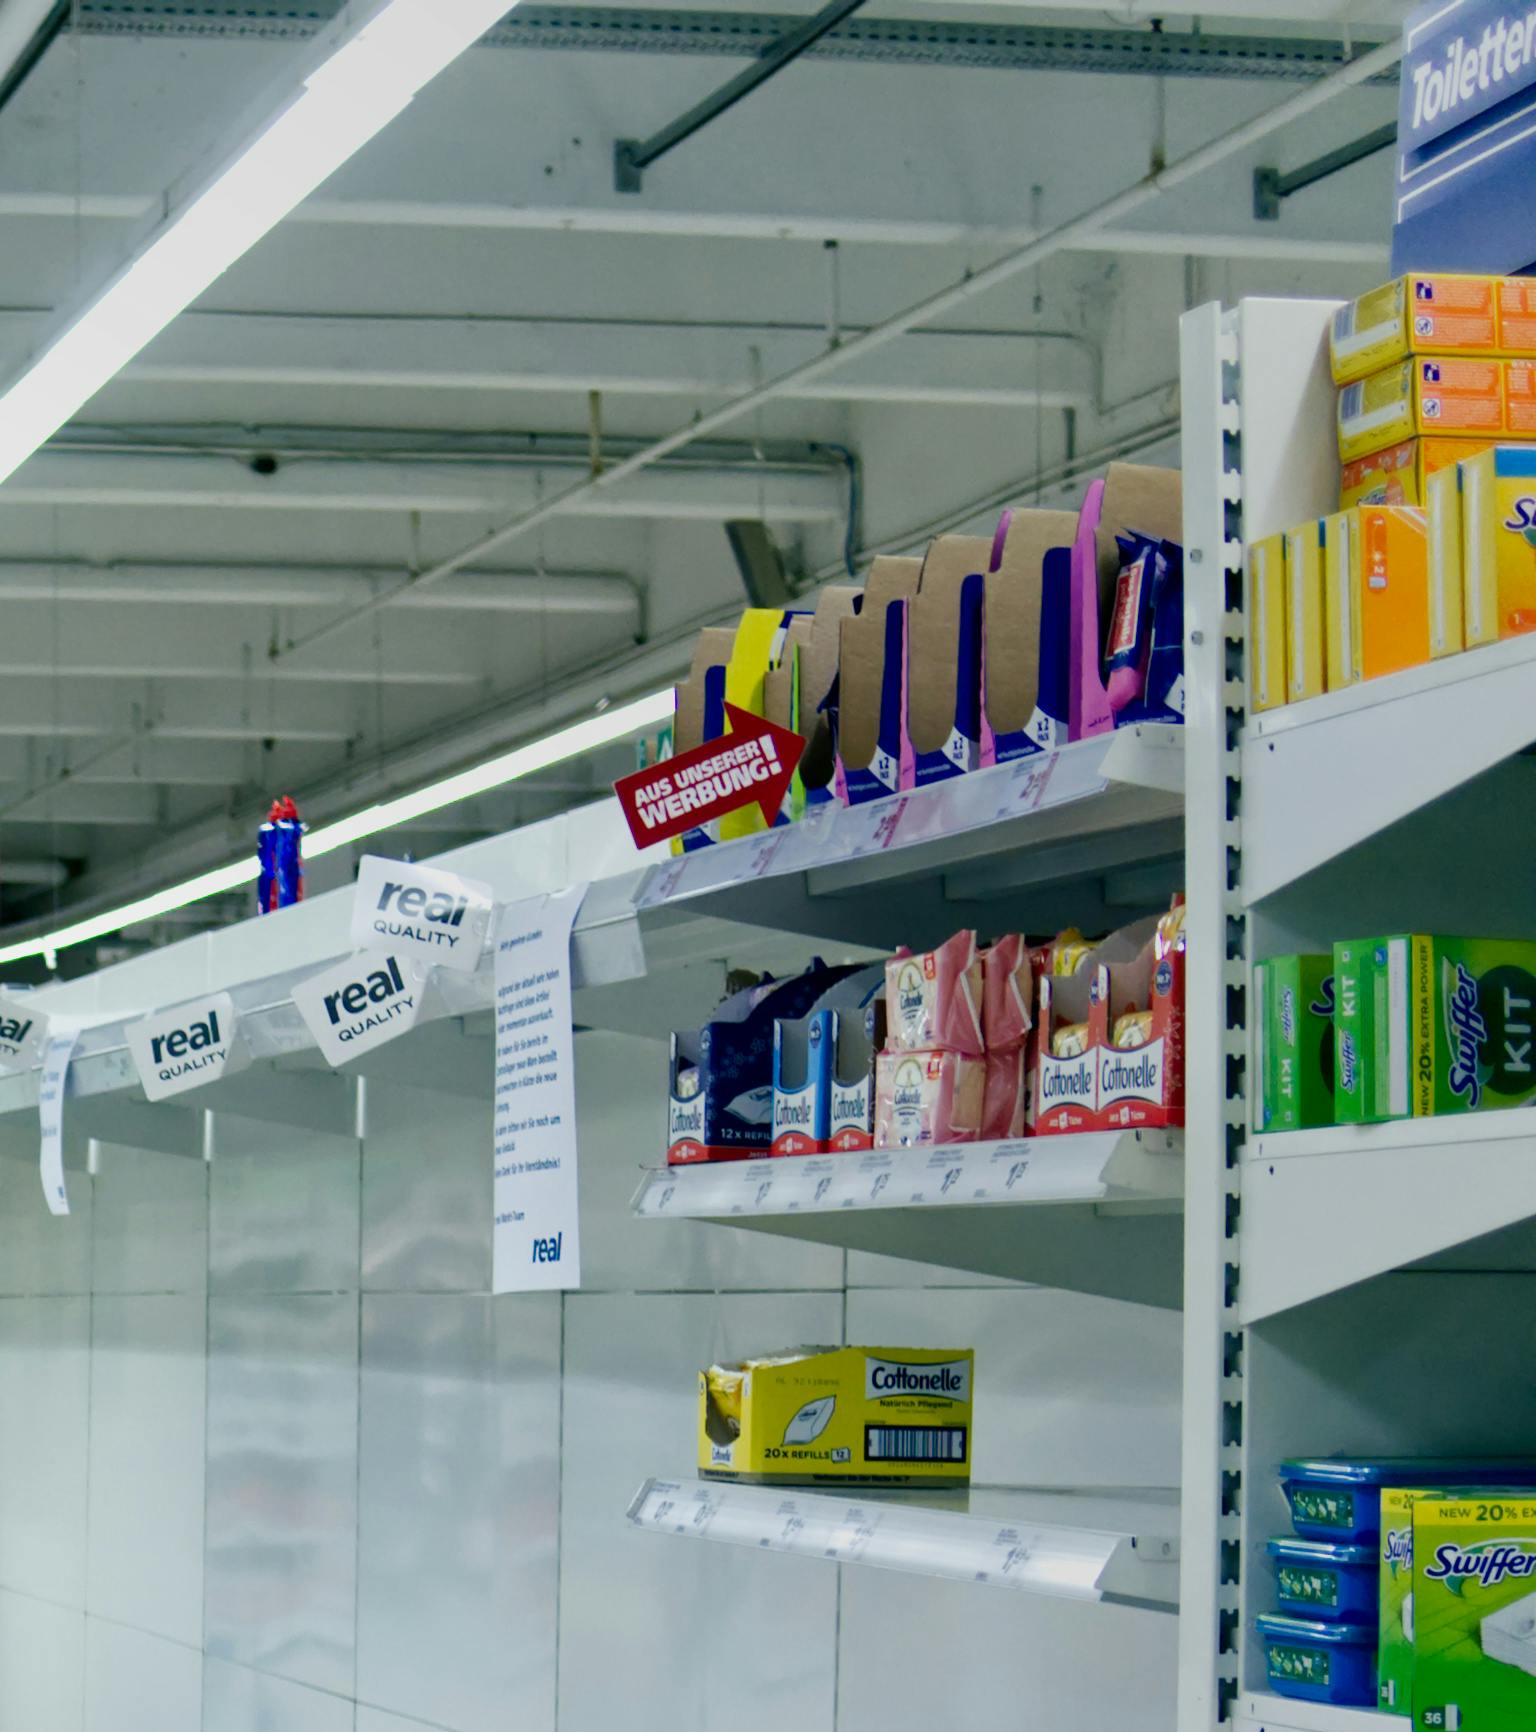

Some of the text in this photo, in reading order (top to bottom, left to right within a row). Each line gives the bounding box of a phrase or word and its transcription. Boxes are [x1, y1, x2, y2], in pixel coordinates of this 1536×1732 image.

[634, 740, 761, 808] AUS UNSERER
[637, 734, 783, 829] WERBUNG!
[377, 881, 469, 927] real
[373, 919, 461, 948] QUALITY
[323, 956, 405, 1025] real
[1342, 975, 1355, 1017] KIT
[338, 996, 414, 1042] QUALITY
[1419, 945, 1432, 1082] 20% EXTRA POWER
[1504, 987, 1532, 1073] KIT
[150, 1010, 221, 1065] real
[1449, 963, 1487, 1109] Swiffer
[159, 1049, 228, 1081] QUALITY
[1043, 1062, 1093, 1099] Cottonelle
[1102, 1055, 1157, 1092] Cottonelle
[1281, 1058, 1292, 1098] KIT
[1341, 1030, 1354, 1091] Swiffer
[672, 1104, 702, 1134] Cottonelle
[776, 1096, 810, 1127] Cottonelle
[833, 1091, 865, 1122] Cottonelle
[532, 1231, 562, 1264] real
[871, 1366, 963, 1392] Cottonelle
[791, 1450, 829, 1460] REFILLS
[1439, 1504, 1518, 1522] NEW 20%
[1426, 1545, 1536, 1585] Swiffer
[1424, 1712, 1442, 1725] 36
